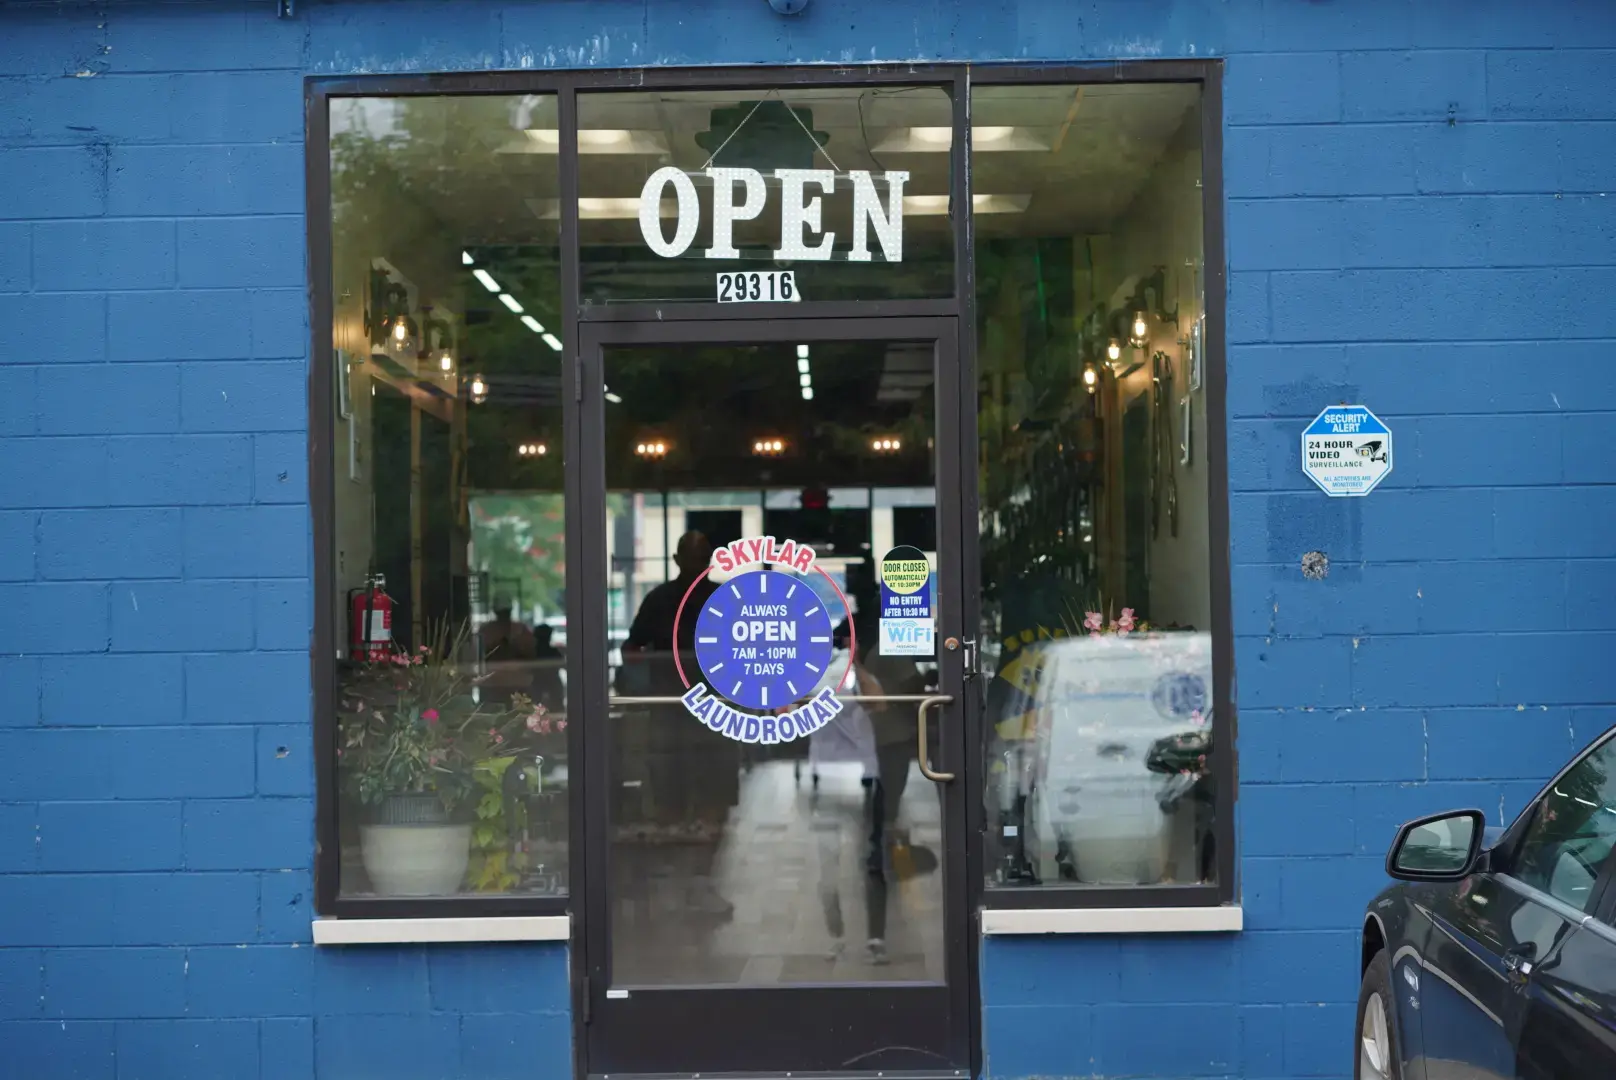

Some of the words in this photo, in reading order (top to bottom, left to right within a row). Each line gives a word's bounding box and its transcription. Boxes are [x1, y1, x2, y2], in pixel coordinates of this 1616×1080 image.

[639, 167, 909, 262] OPEN
[719, 272, 793, 301] 29316
[1324, 413, 1368, 424] SECURITY
[1332, 423, 1360, 433] ALERT
[1309, 441, 1321, 449] 24
[1309, 451, 1340, 459] VIDEO
[715, 538, 813, 572] SKYLAR
[884, 563, 901, 572] DOOR
[902, 563, 926, 572] CLOSES
[890, 596, 900, 606] NO
[901, 596, 922, 605] ENTRY
[740, 604, 788, 617] ALWAYS
[884, 608, 902, 617] AFTER
[902, 608, 918, 617] 10:30
[919, 608, 928, 616] PM
[732, 620, 796, 641] OPEN
[888, 627, 931, 642] WiFi
[732, 647, 757, 660] 7AM
[766, 647, 796, 660] 10PM
[744, 663, 751, 675] 7
[753, 663, 785, 675] DAYS
[684, 686, 841, 741] LAUNDROMAT
